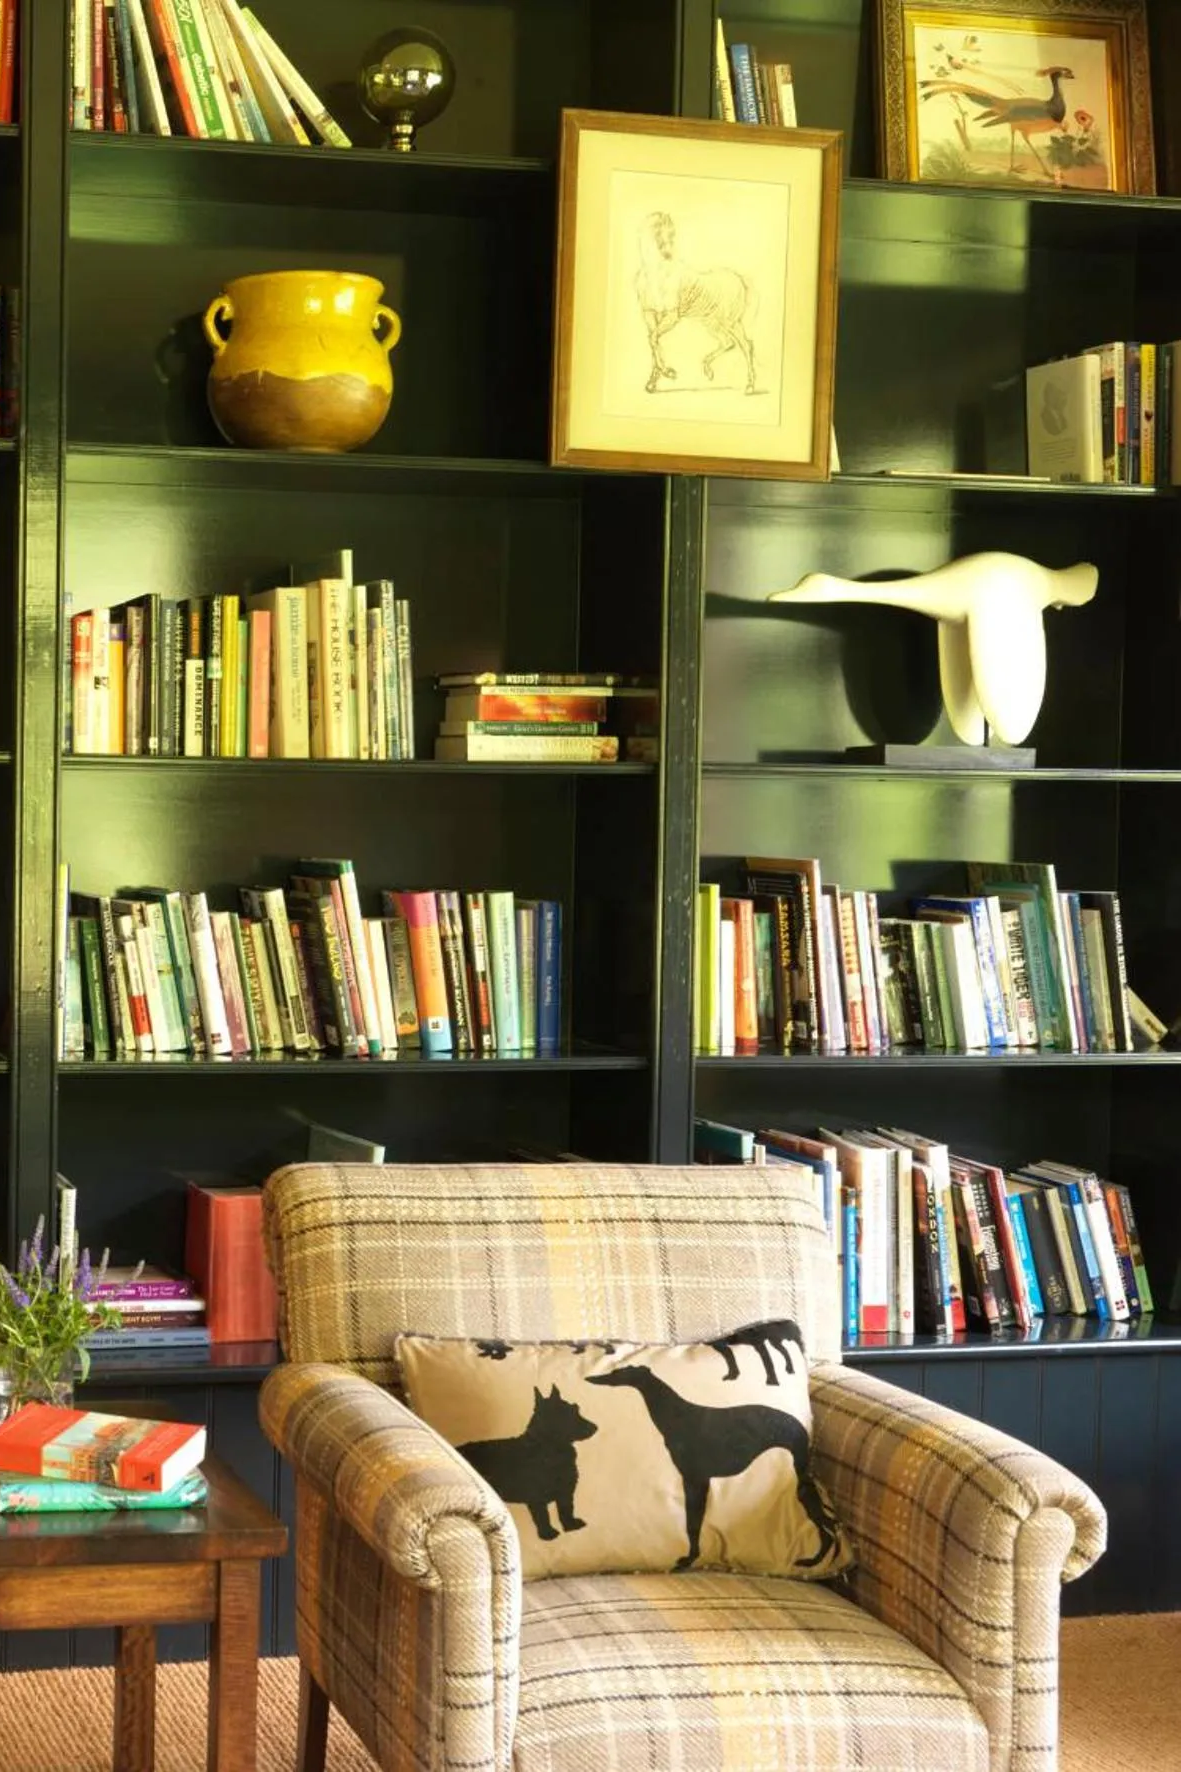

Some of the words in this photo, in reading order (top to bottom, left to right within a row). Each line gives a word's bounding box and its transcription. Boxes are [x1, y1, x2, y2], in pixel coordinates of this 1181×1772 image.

[287, 596, 302, 631] jamie
[330, 588, 340, 613] THE
[331, 617, 342, 667] HOUSE
[399, 624, 409, 658] CAIN
[290, 646, 300, 677] home
[194, 666, 202, 736] DOMINANCE
[332, 671, 343, 713] BOOK
[778, 903, 791, 966] SAMSARA
[1008, 927, 1025, 964] WHITE
[1012, 962, 1032, 1000] TIGER
[927, 1181, 939, 1253] LONDON
